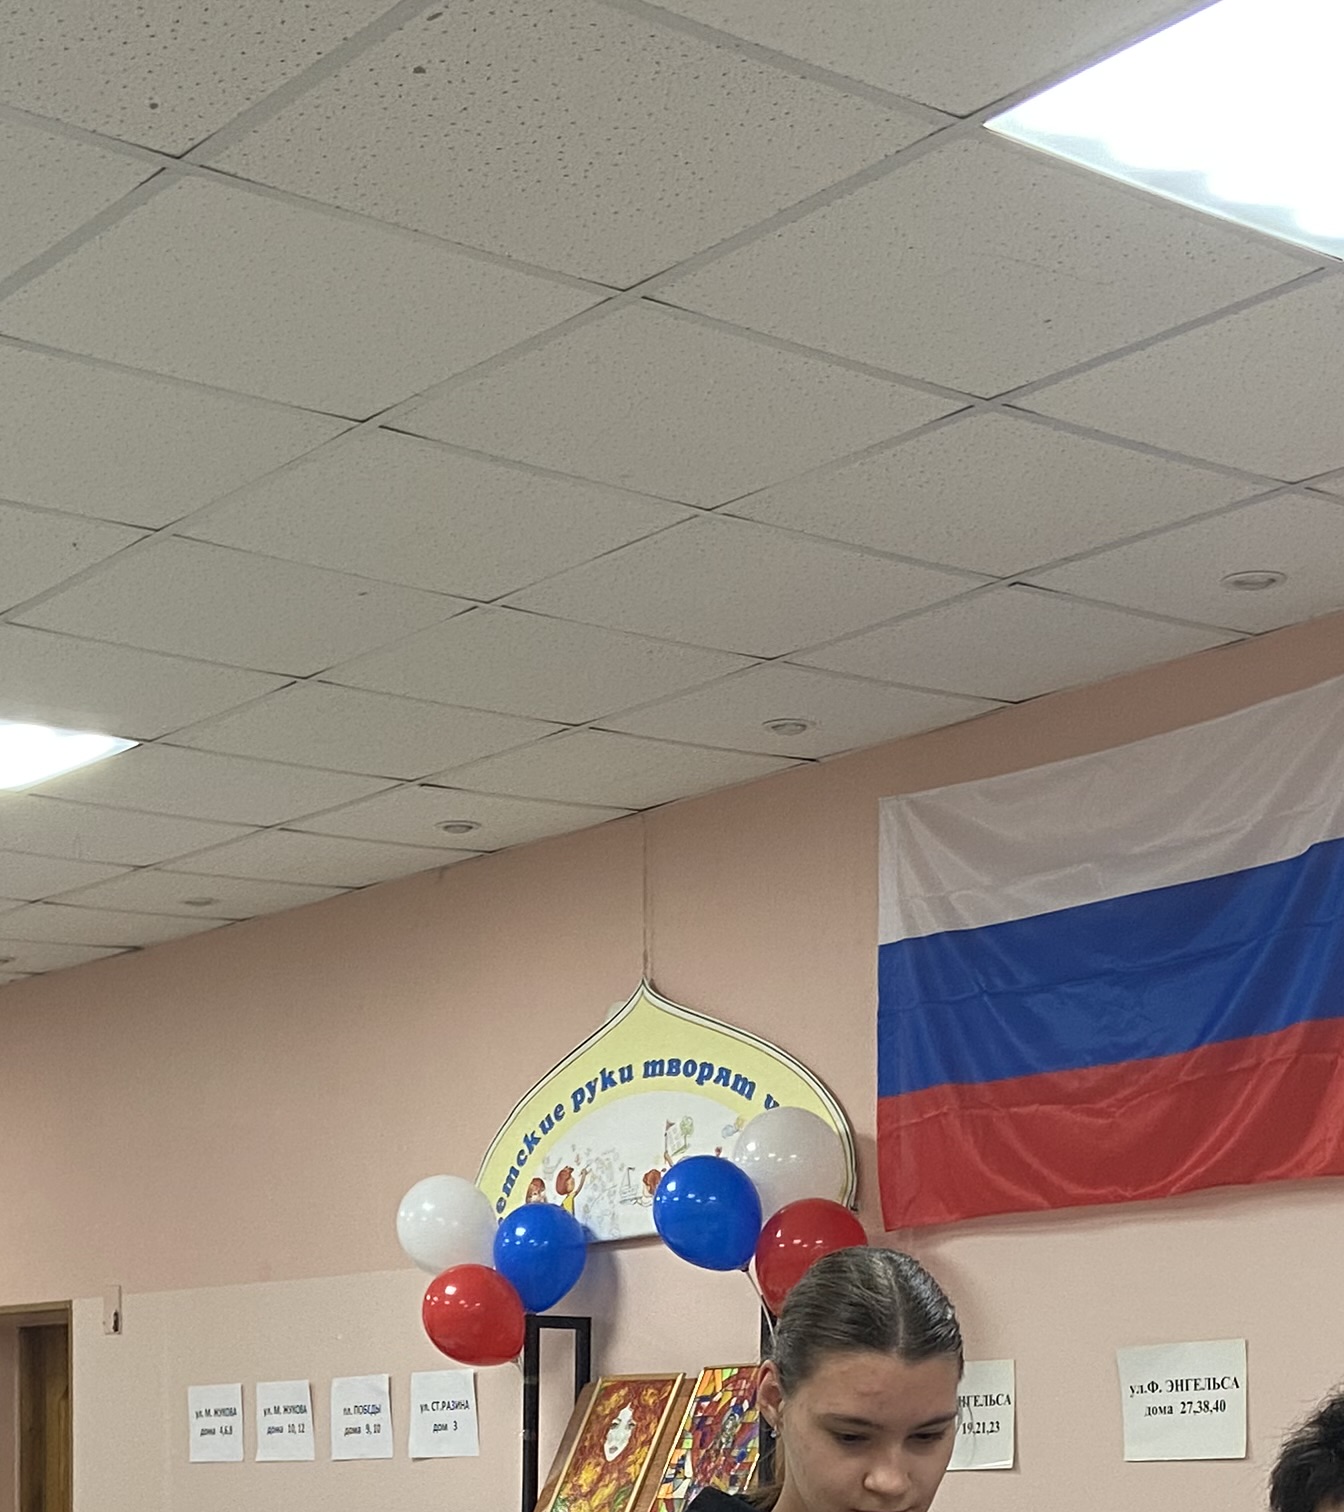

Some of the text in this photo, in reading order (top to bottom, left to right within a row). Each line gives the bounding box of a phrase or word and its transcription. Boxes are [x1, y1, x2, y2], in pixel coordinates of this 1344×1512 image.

[495, 1057, 757, 1223] етские руки творят
[1128, 1376, 1240, 1398] ул.Ф. ЭНГЕЛЬСА
[958, 1393, 1011, 1408] НГЕЛЬСА
[1144, 1399, 1227, 1418] дома 27,38,40
